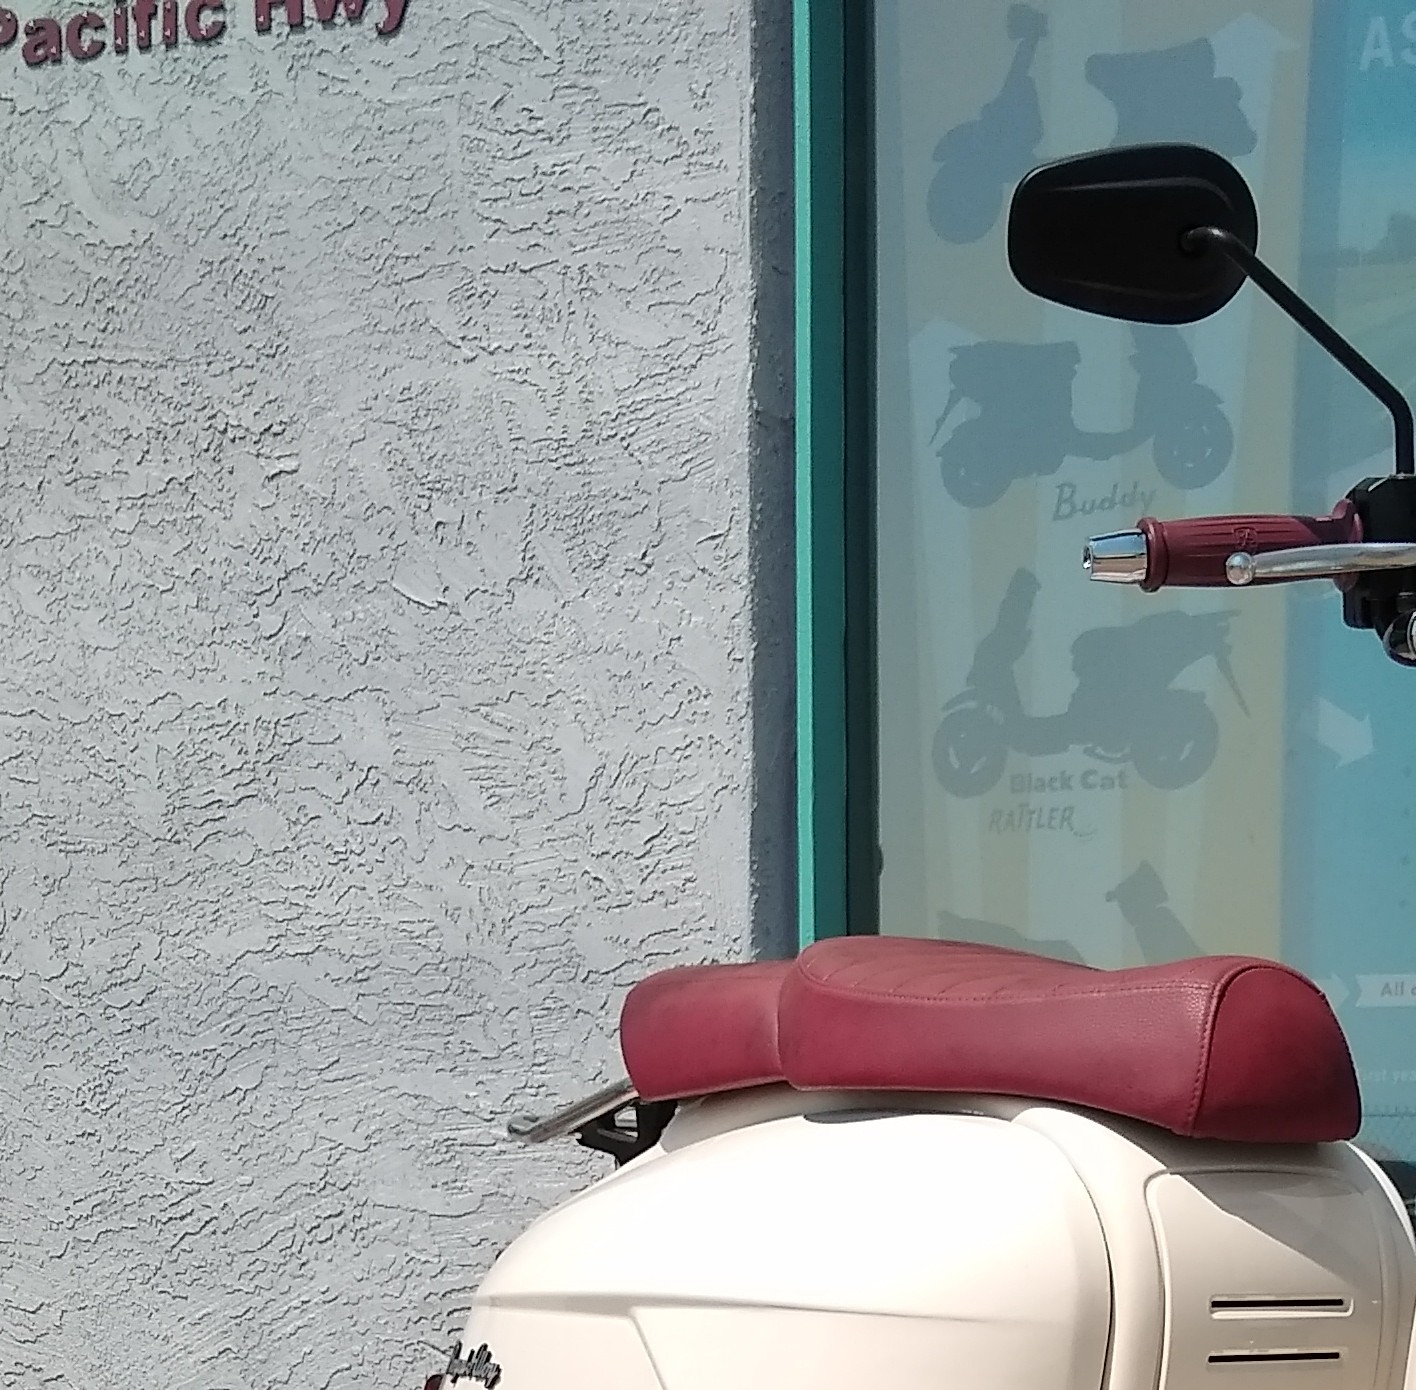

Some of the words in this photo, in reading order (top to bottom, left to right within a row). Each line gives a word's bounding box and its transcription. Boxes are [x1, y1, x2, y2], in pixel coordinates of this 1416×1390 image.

[1053, 481, 1156, 521] Buddy
[1010, 769, 1075, 794] Black
[1080, 768, 1128, 791] Cat
[988, 802, 1080, 836] RATTLER
[1381, 981, 1404, 997] All
